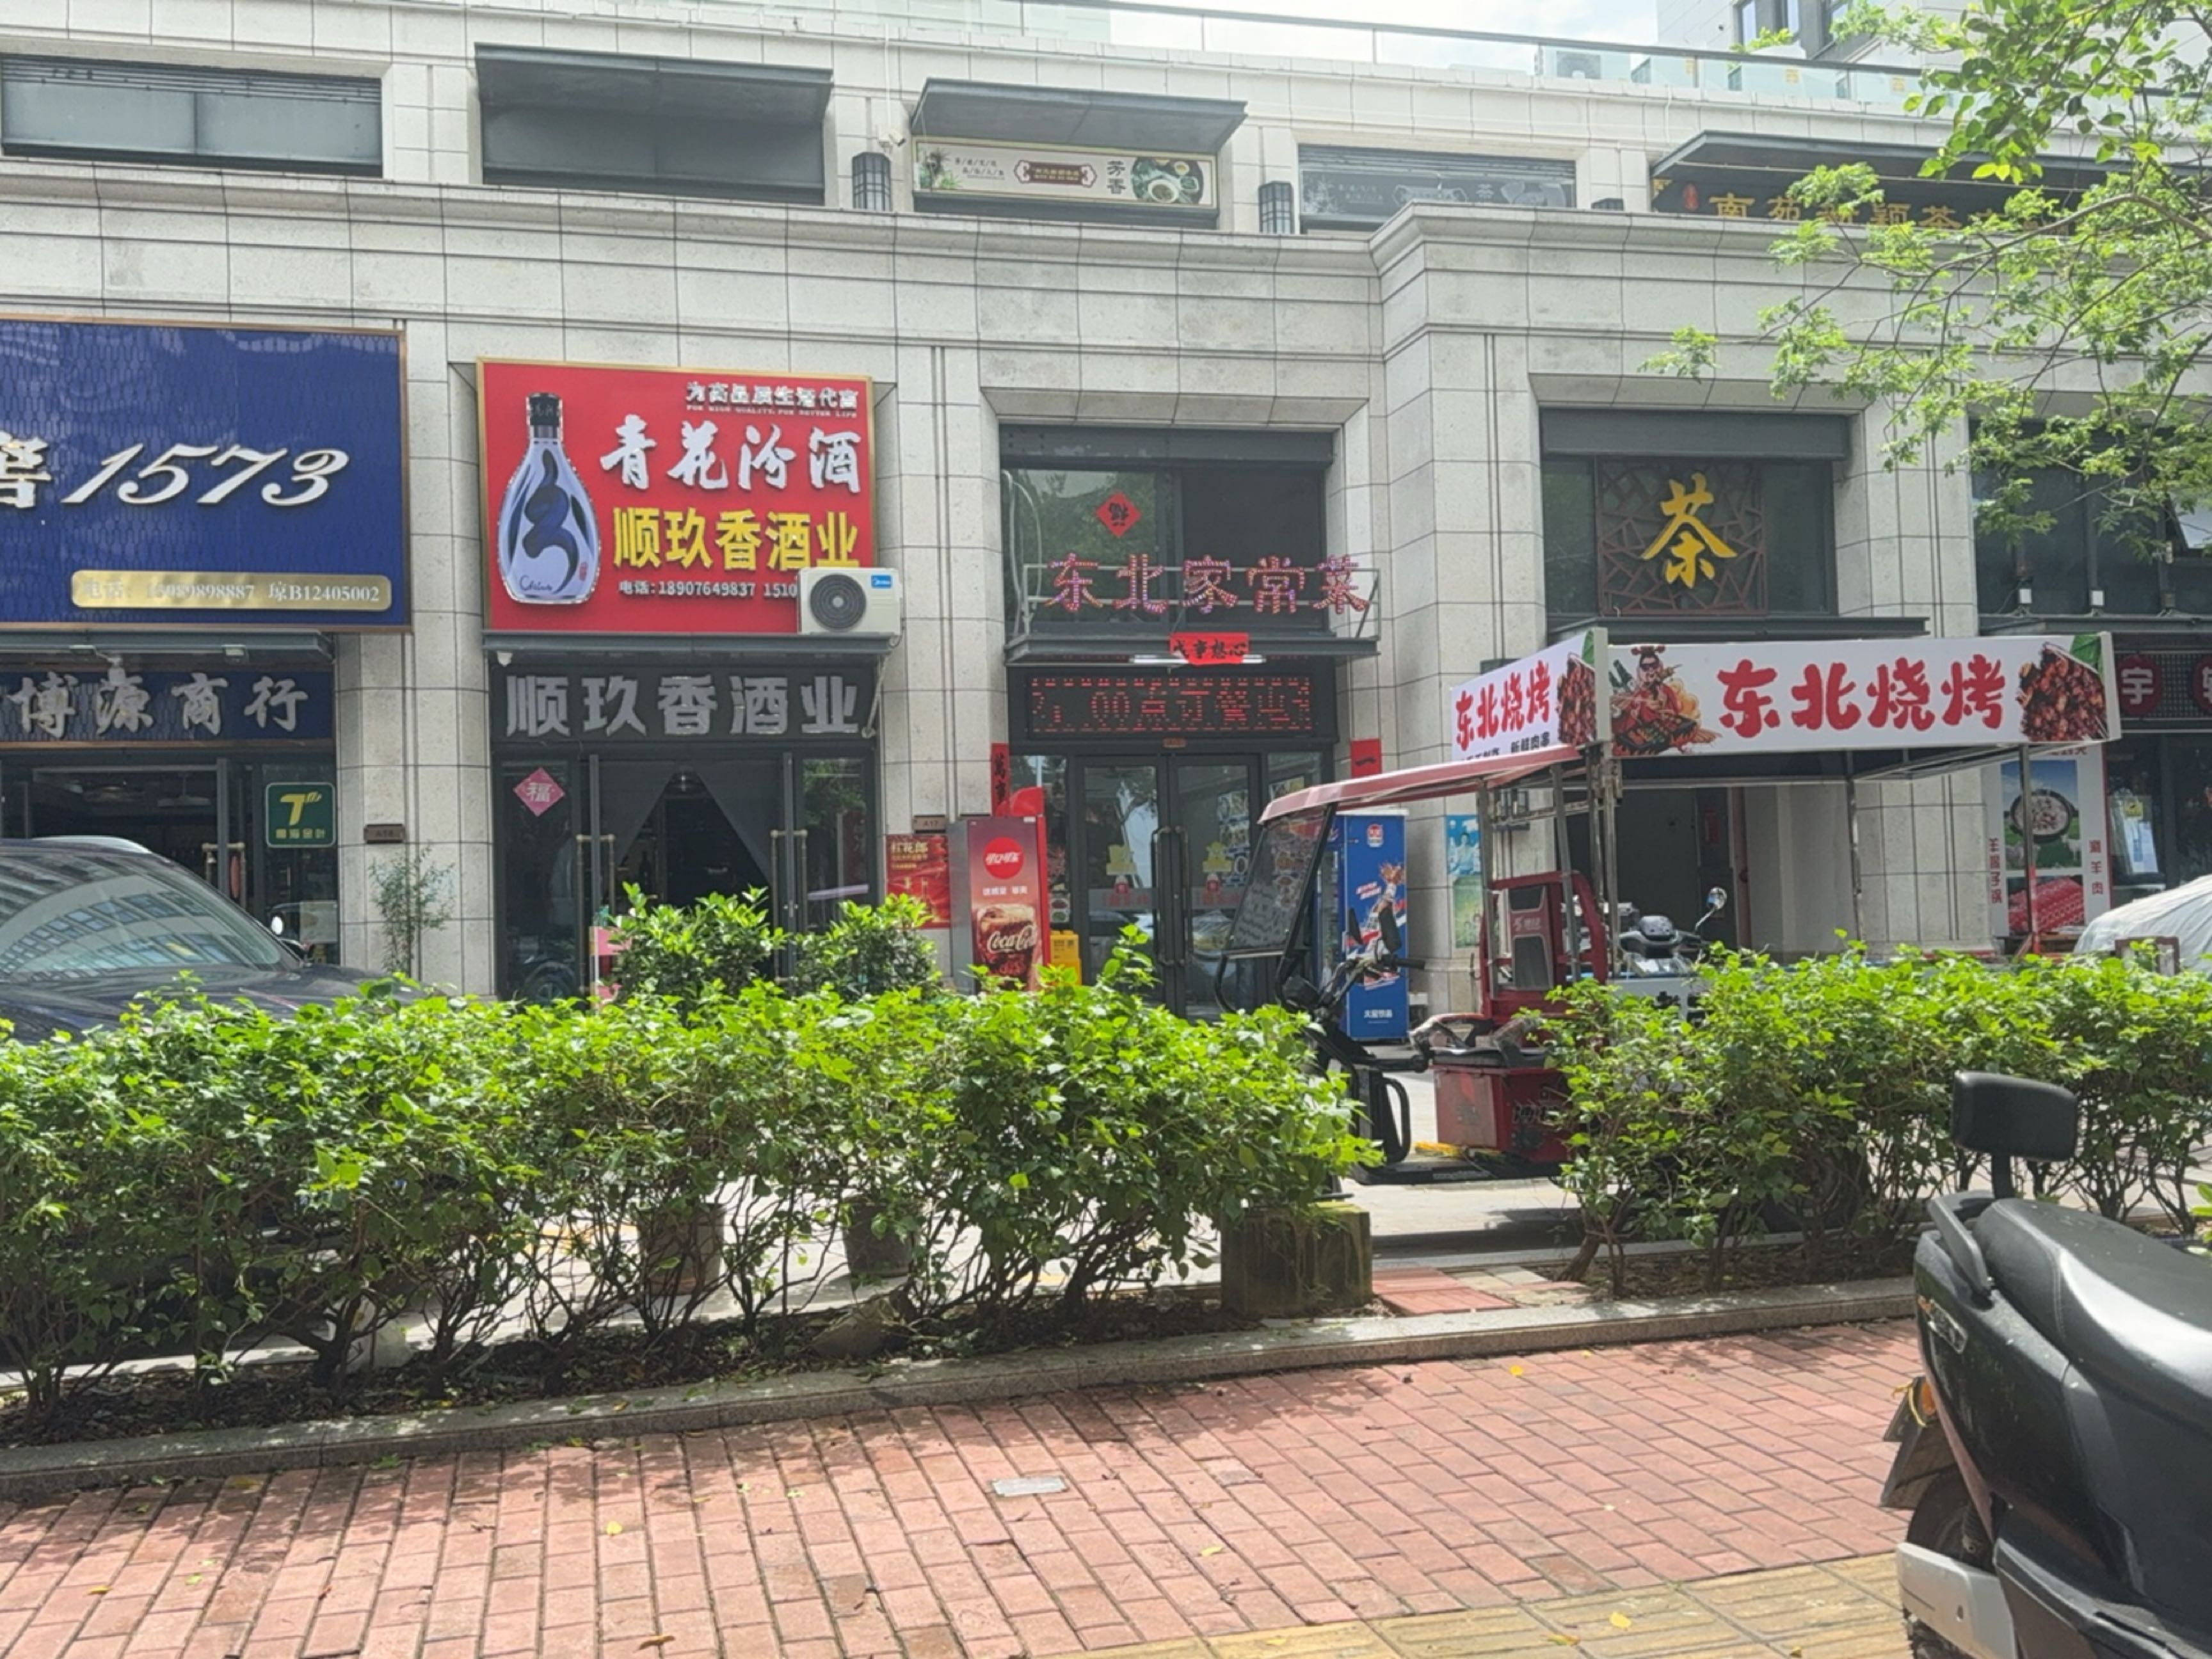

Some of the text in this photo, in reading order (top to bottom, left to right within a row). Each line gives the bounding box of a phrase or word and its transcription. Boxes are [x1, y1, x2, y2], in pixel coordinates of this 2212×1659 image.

[686, 381, 858, 410] 为高品质生活代言
[61, 443, 349, 506] 1573
[600, 413, 862, 495] 青花汾酒
[613, 508, 860, 572] 顺玖香酒业
[1639, 472, 1738, 589] 茶
[1045, 552, 1370, 614] 东北家常菜
[8, 669, 309, 739] 博源商行
[506, 675, 860, 737] 顺玖香酒业
[1455, 659, 1551, 751] 东北烧烤
[1717, 653, 2005, 739] 东北烧烤
[2120, 666, 2154, 703] 宇
